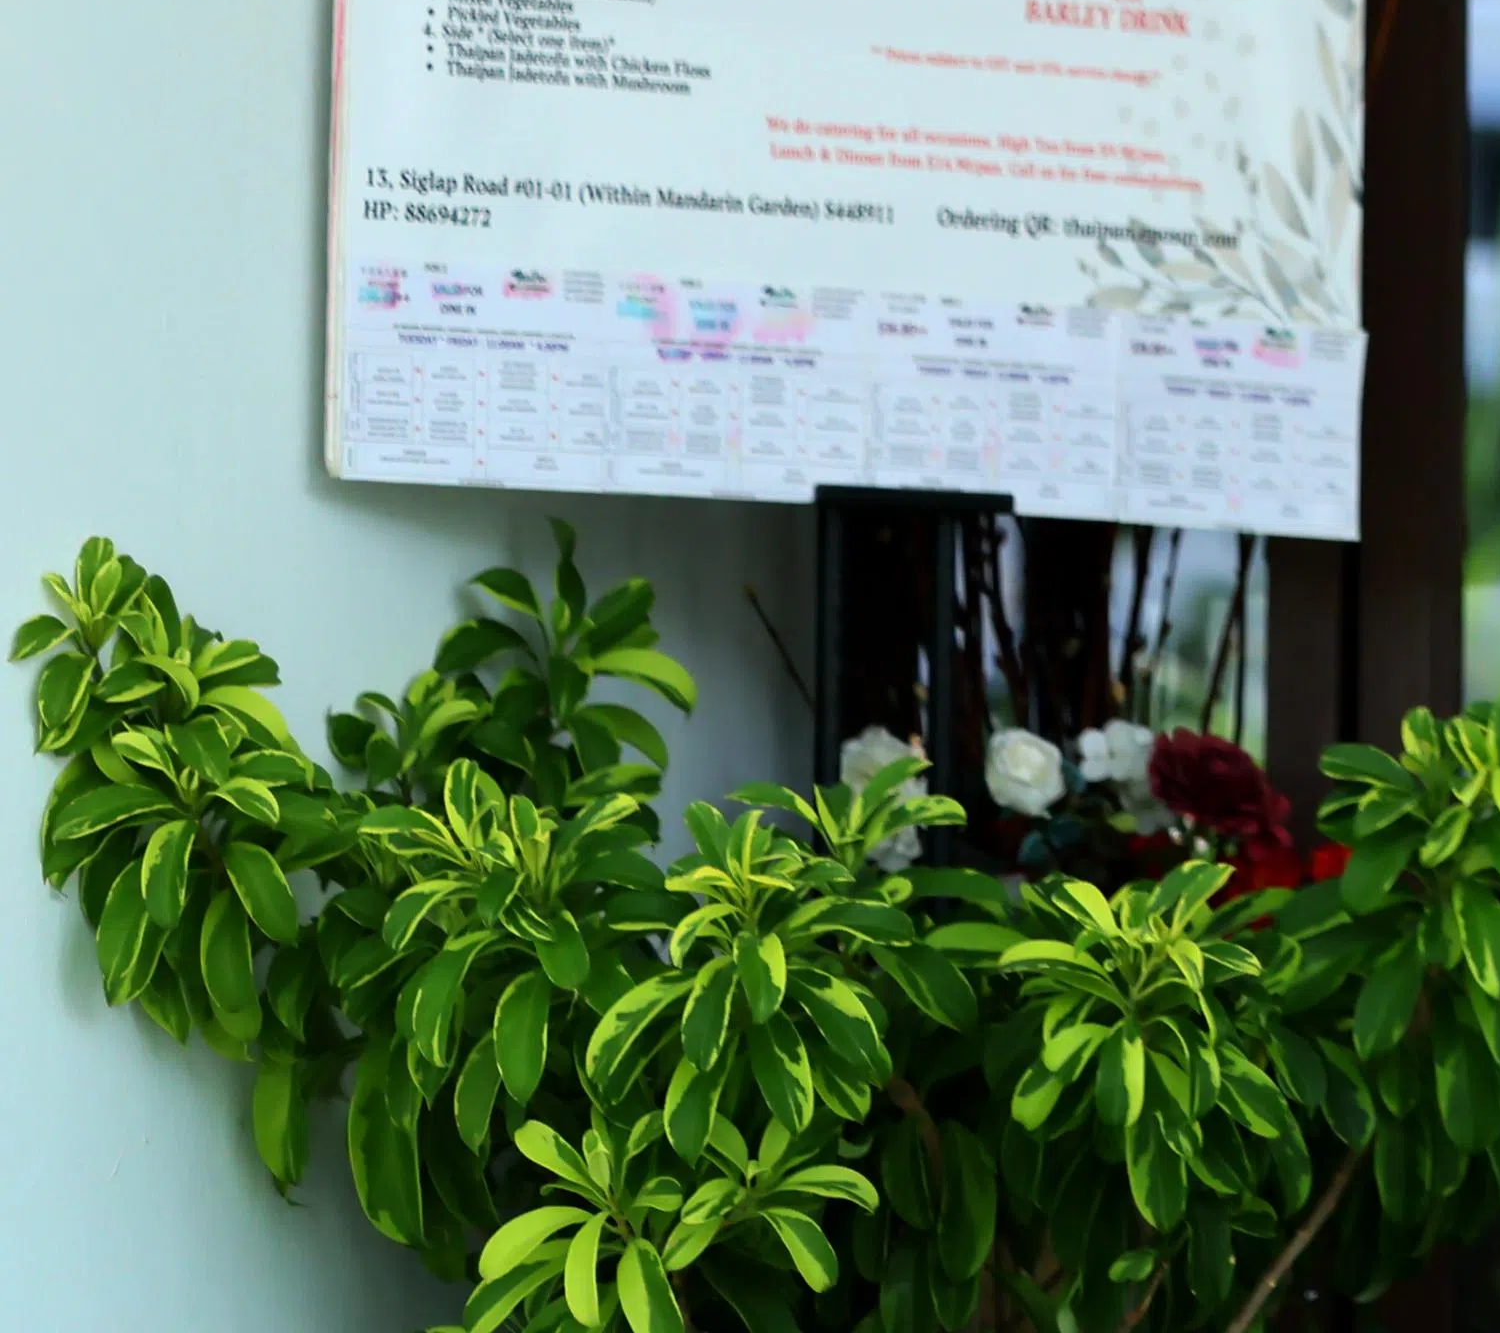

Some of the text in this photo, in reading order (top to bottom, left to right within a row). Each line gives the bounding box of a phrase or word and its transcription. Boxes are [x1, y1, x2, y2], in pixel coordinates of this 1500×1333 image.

[1120, 7, 1188, 34] DRINK
[400, 170, 457, 196] Siglap
[463, 174, 508, 196] Road
[513, 178, 571, 200] #01-01
[578, 183, 651, 205] (Within
[656, 188, 743, 211] Mandarin
[747, 194, 819, 219] Garden)
[363, 199, 490, 227] HP: 88694272
[936, 207, 1020, 237] Ordering
